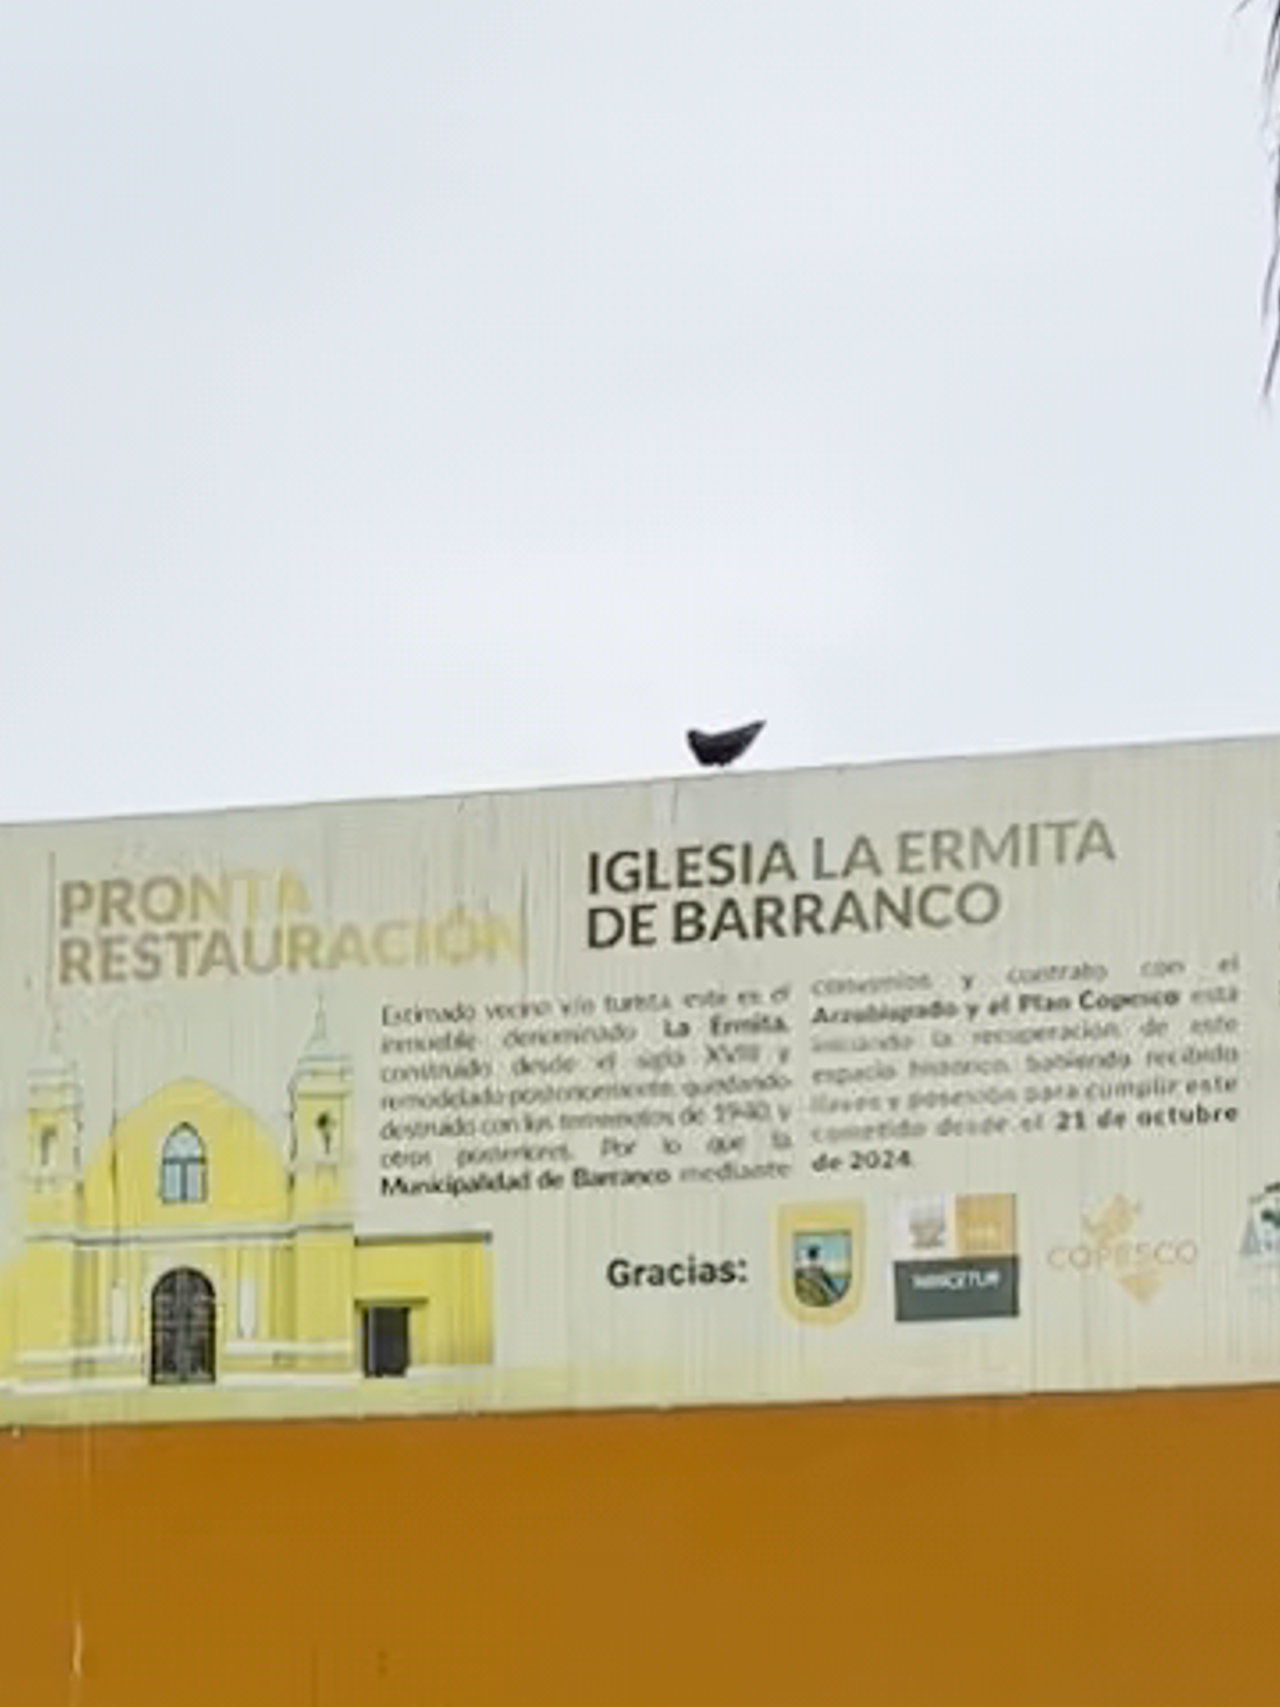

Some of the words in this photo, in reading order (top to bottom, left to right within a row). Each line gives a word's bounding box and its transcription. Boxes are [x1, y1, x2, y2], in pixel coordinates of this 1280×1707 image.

[588, 840, 796, 894] IGLESIA
[813, 829, 889, 880] LA
[897, 819, 1115, 874] ERMITA
[59, 864, 311, 930] PRONTA
[589, 905, 657, 949] DE
[672, 882, 1001, 943] BARRANCO
[59, 905, 525, 986] RESTAURACIÓN
[382, 1004, 475, 1026] Estimado
[967, 1003, 979, 1022] y
[1020, 991, 1071, 1013] Plan
[503, 1024, 636, 1048] denominado
[664, 1018, 690, 1038] La
[381, 1060, 491, 1083] construido
[1055, 1109, 1086, 1131] 21
[1097, 1109, 1126, 1130] de
[1137, 1103, 1238, 1127] octubre
[812, 1152, 841, 1173] de
[381, 1168, 530, 1198] Municipalidad
[536, 1167, 564, 1189] de
[574, 1166, 670, 1189] Barranco
[679, 1161, 791, 1184] mediante
[1047, 1239, 1198, 1270] COPESCO
[607, 1256, 748, 1289] Gracias:
